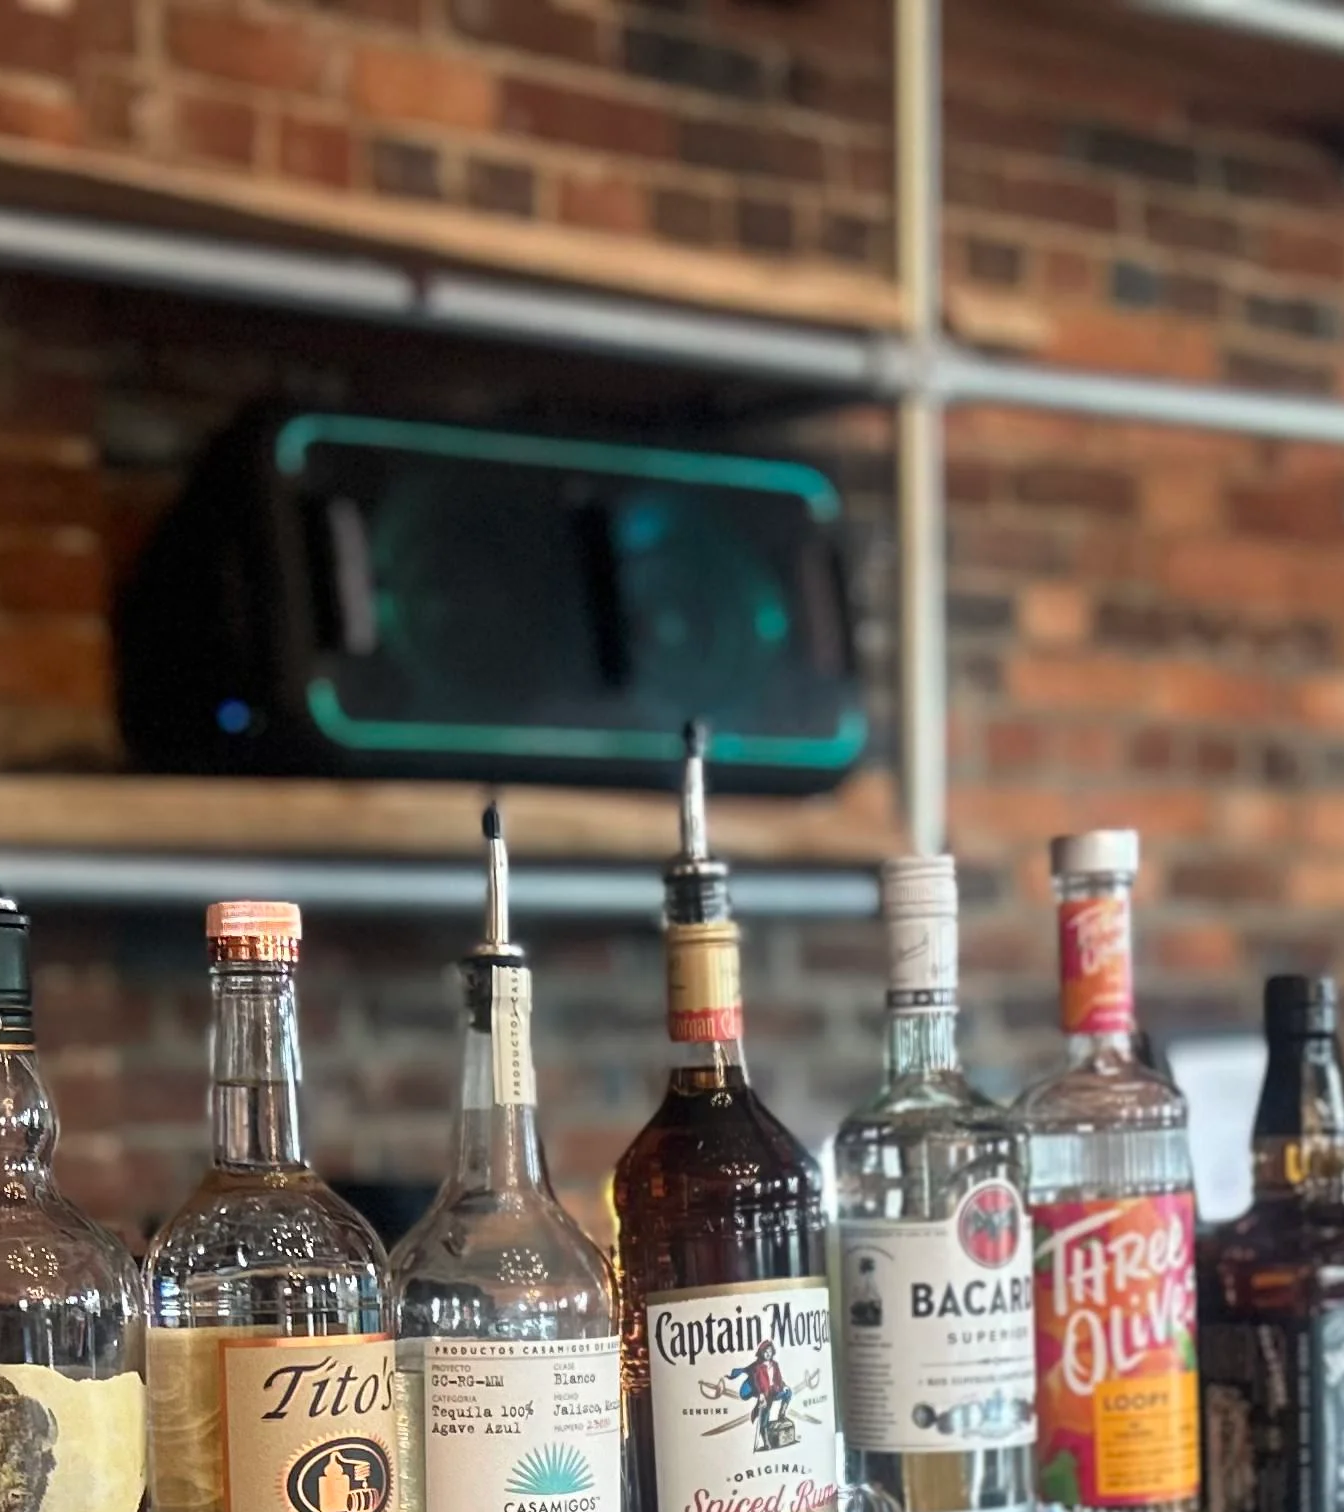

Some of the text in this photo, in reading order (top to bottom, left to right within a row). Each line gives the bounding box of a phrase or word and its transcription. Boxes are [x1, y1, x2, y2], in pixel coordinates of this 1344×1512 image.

[654, 1306, 762, 1366] Captain
[435, 1346, 514, 1356] PRODUCTOS
[261, 1356, 396, 1420] Tito's
[554, 1372, 596, 1386] Blanco
[431, 1400, 535, 1420] Tequila 100%
[431, 1422, 522, 1436] Agave Azul
[734, 1463, 807, 1483] ORIGINAL
